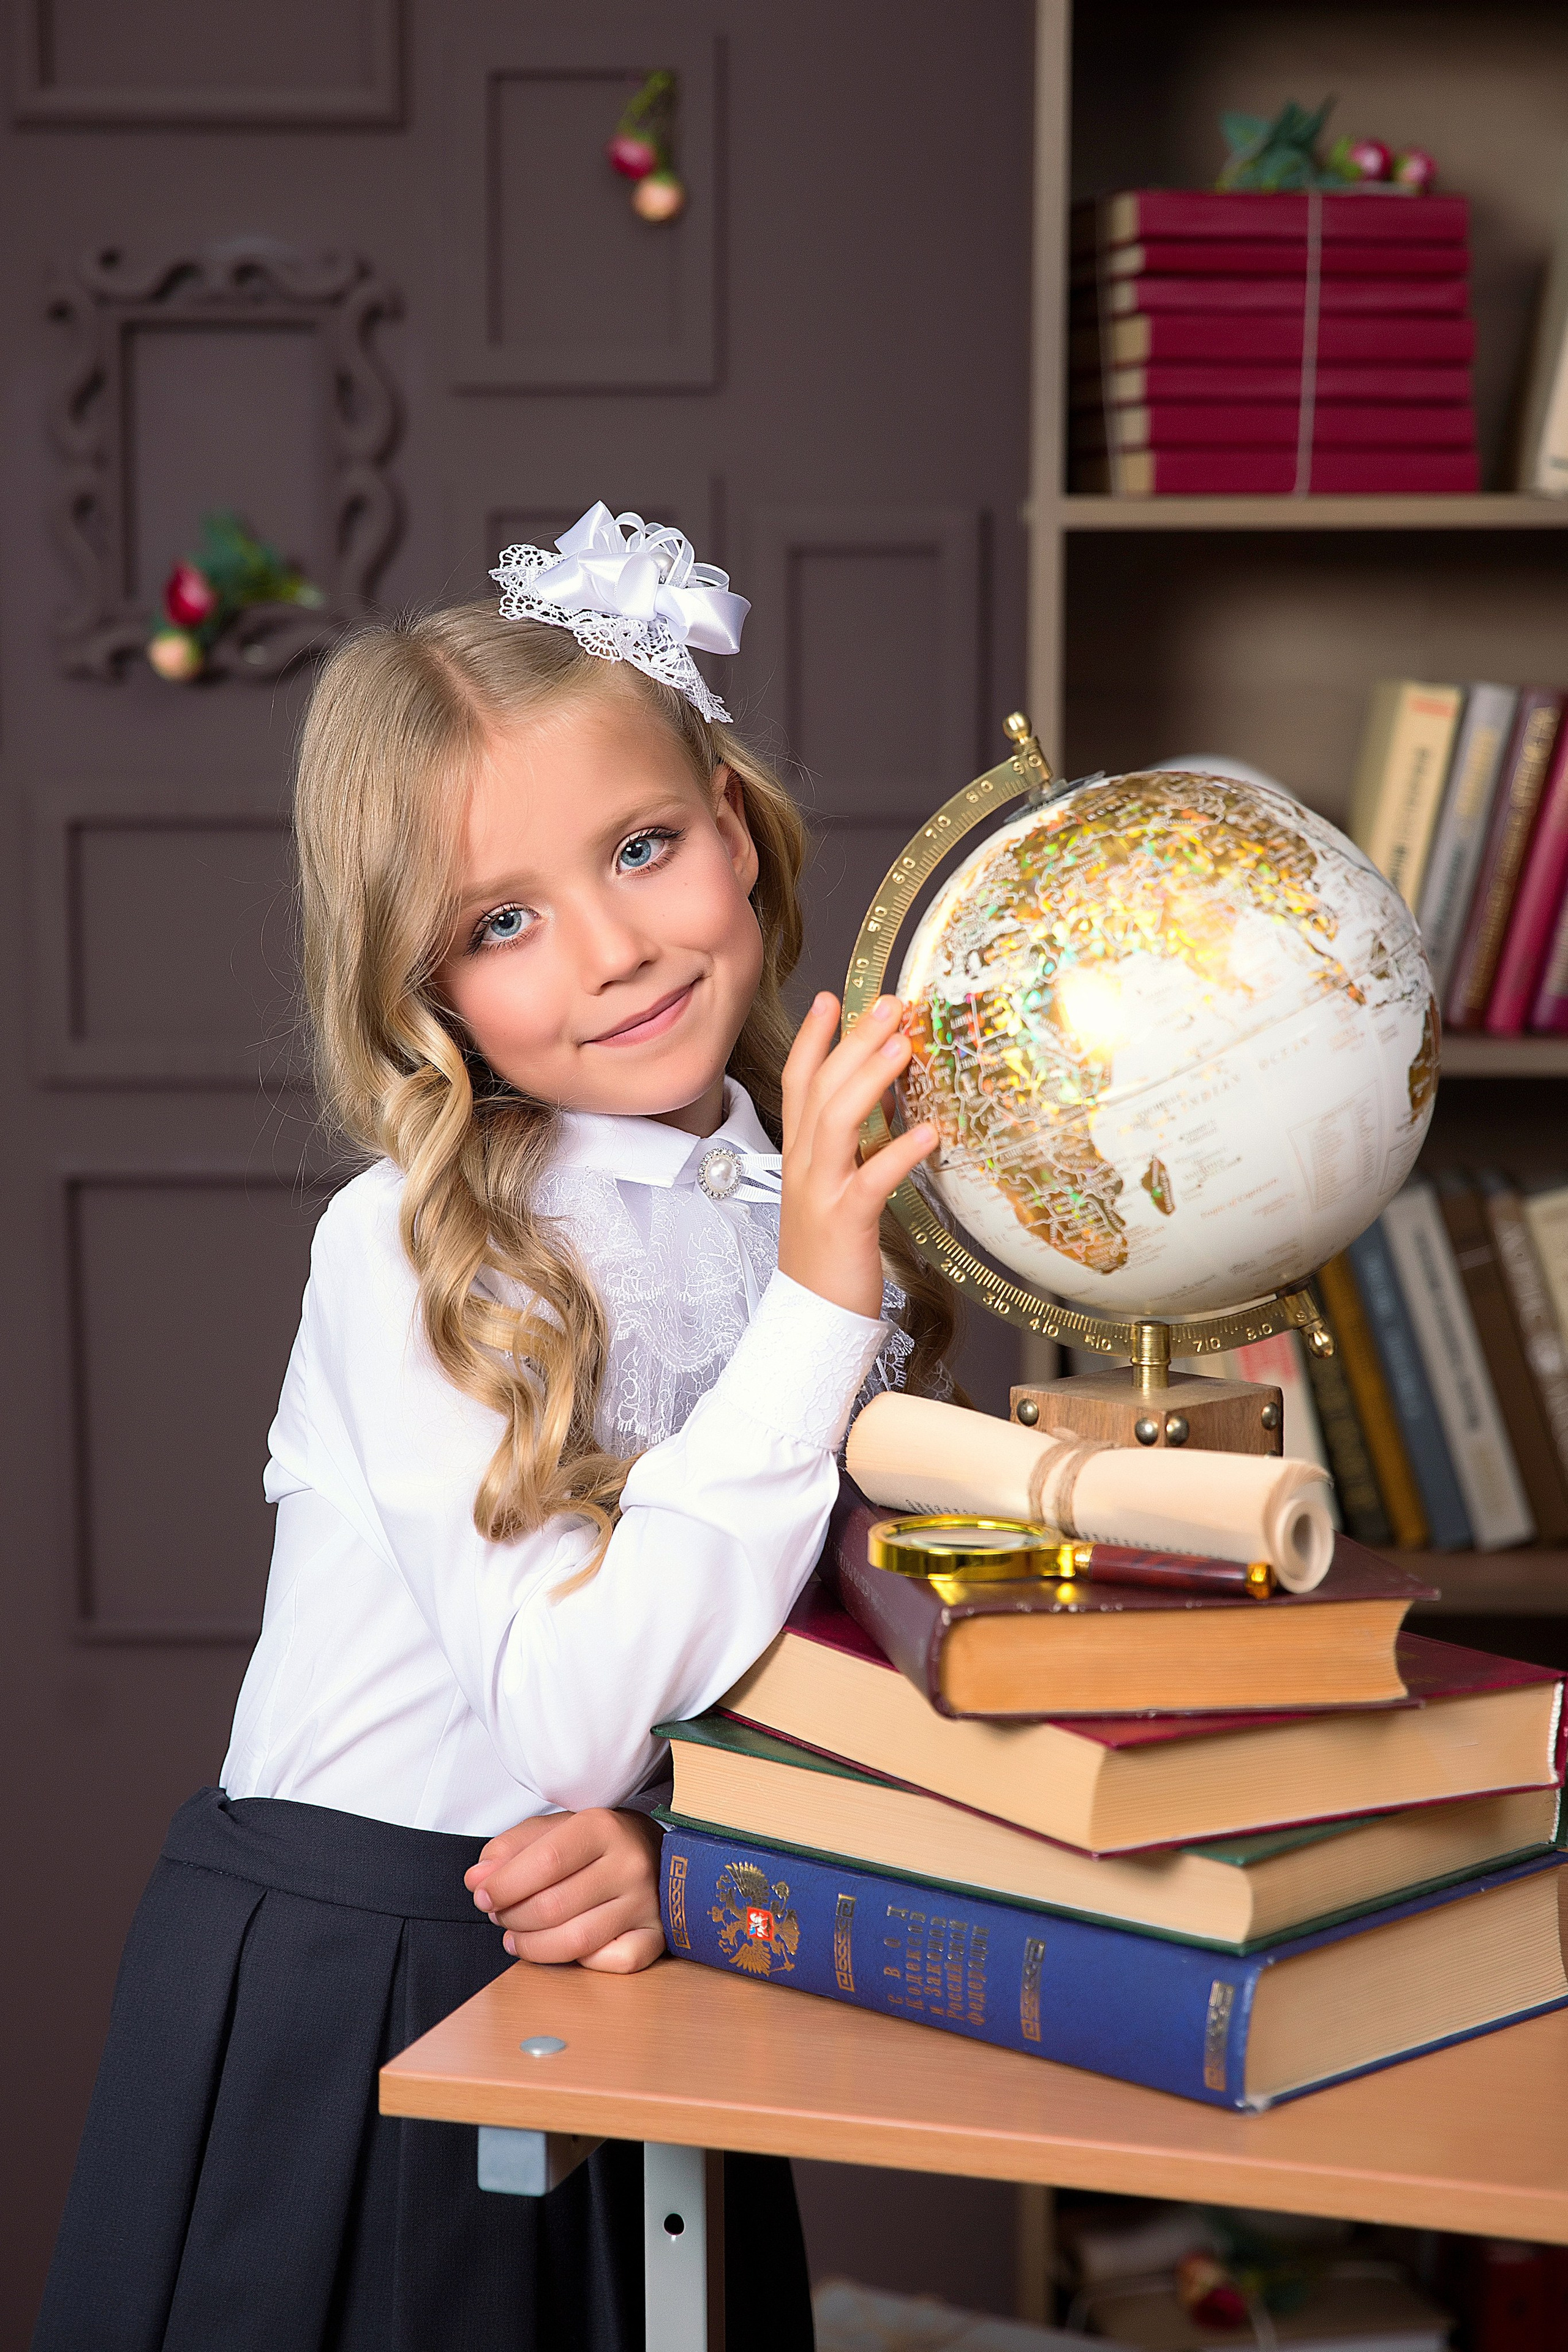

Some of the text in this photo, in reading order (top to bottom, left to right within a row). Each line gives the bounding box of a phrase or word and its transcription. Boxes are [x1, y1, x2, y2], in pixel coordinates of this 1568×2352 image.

[892, 857, 916, 884] 60
[867, 905, 888, 932] 50
[851, 957, 870, 989] 40
[940, 1258, 966, 1283] 20
[982, 1292, 1010, 1314] 30
[1029, 1317, 1060, 1337] 40
[1246, 1323, 1273, 1341] 80
[1085, 1334, 1112, 1351] 50
[1193, 1336, 1221, 1352] 70
[906, 1912, 926, 2010] Кодексов
[924, 1917, 946, 1997] Законов
